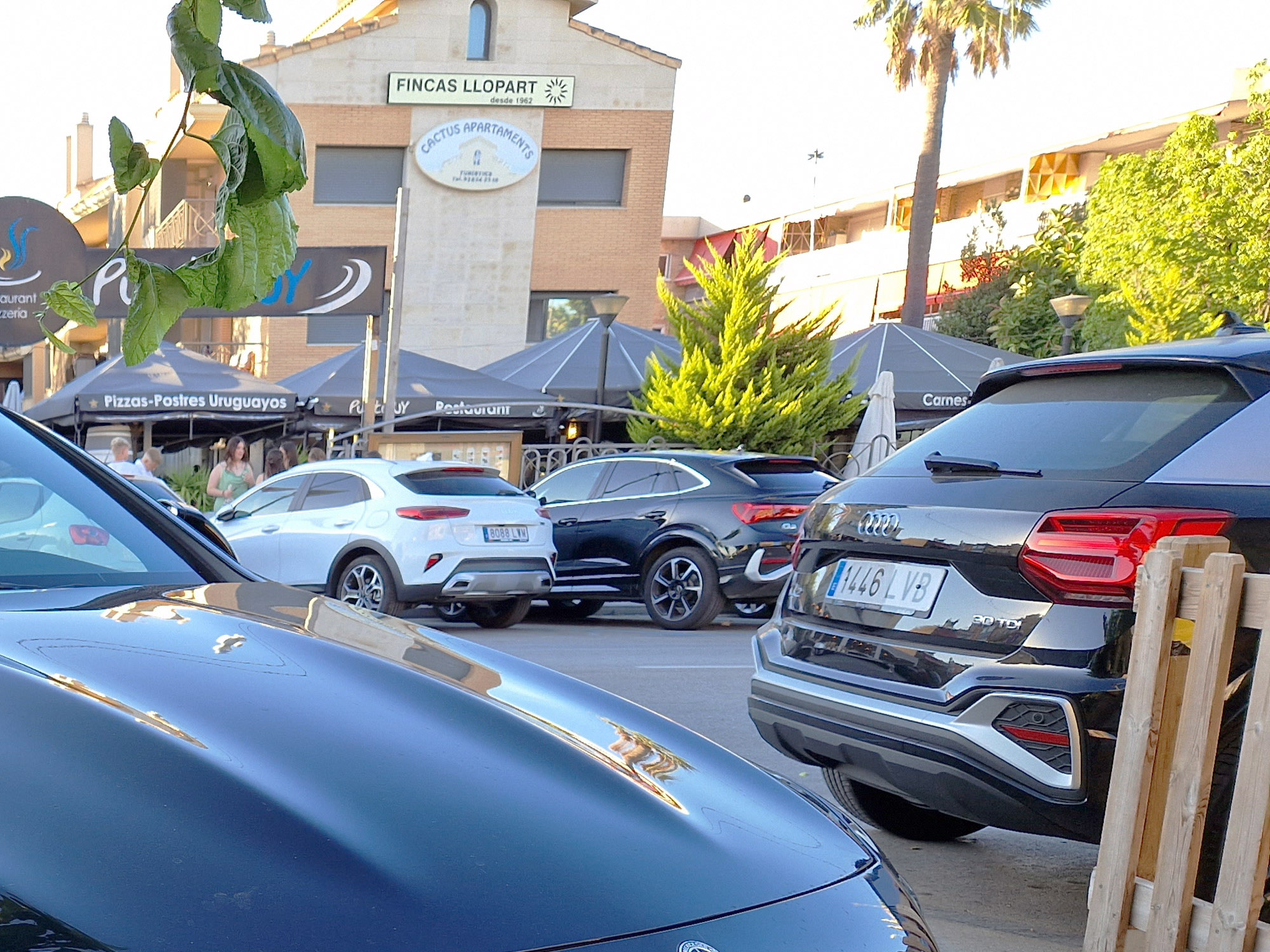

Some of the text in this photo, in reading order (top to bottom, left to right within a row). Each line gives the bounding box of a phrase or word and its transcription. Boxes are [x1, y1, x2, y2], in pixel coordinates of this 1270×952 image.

[396, 78, 538, 94] FINCAS LLOPART
[490, 96, 514, 104] desde
[420, 121, 534, 160] CACTUS APARTAMENTS
[104, 393, 287, 411] Pizzas-Postres Uruguayos
[490, 528, 509, 538] 8088
[841, 565, 932, 603] 1446 LVB
[996, 618, 1022, 631] TDI
